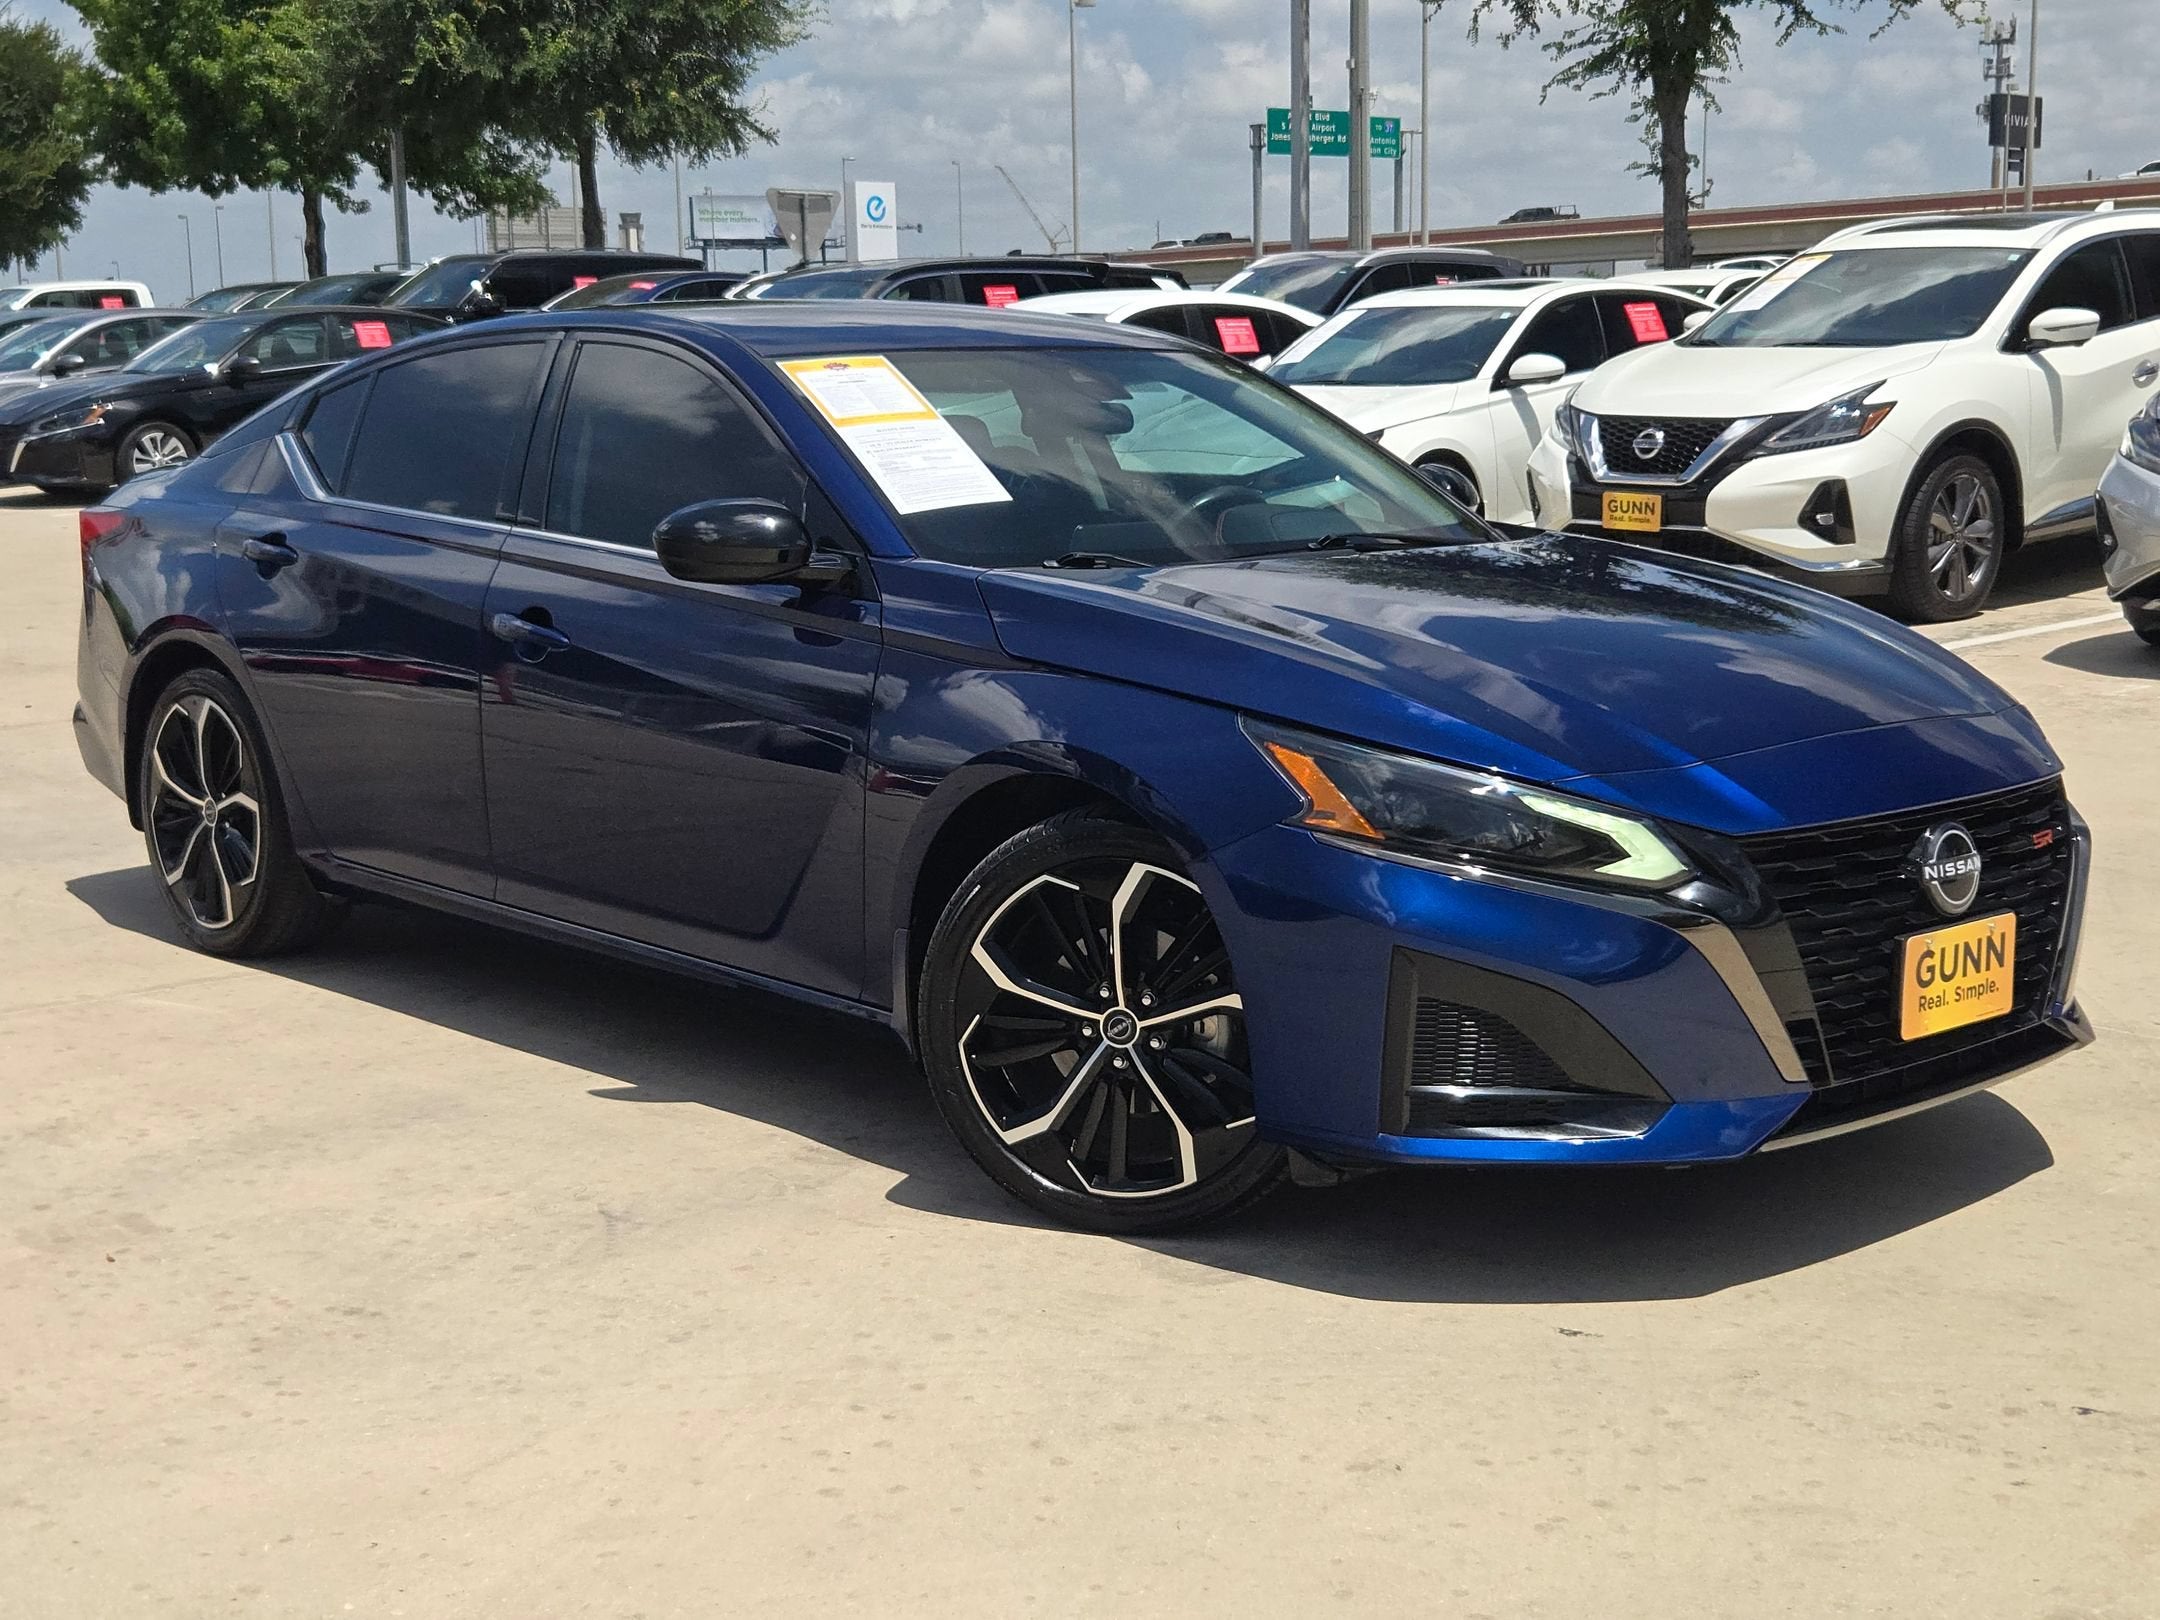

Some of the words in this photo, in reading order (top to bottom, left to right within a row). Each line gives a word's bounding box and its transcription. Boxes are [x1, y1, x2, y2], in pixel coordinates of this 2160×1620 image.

[1314, 112, 1330, 121] Blvd
[1281, 121, 1286, 130] S
[1311, 122, 1336, 133] Airport
[1271, 133, 1291, 141] Jones
[1337, 134, 1346, 143] Rd
[1384, 146, 1397, 157] City
[724, 209, 743, 217] every
[1608, 499, 1655, 515] GUNN
[2033, 829, 2053, 849] SR
[1924, 855, 1981, 880] NISSAN
[1915, 932, 2006, 989] GUNN
[1918, 988, 1949, 1013] Real.
[1954, 977, 2000, 1003] Simple.
